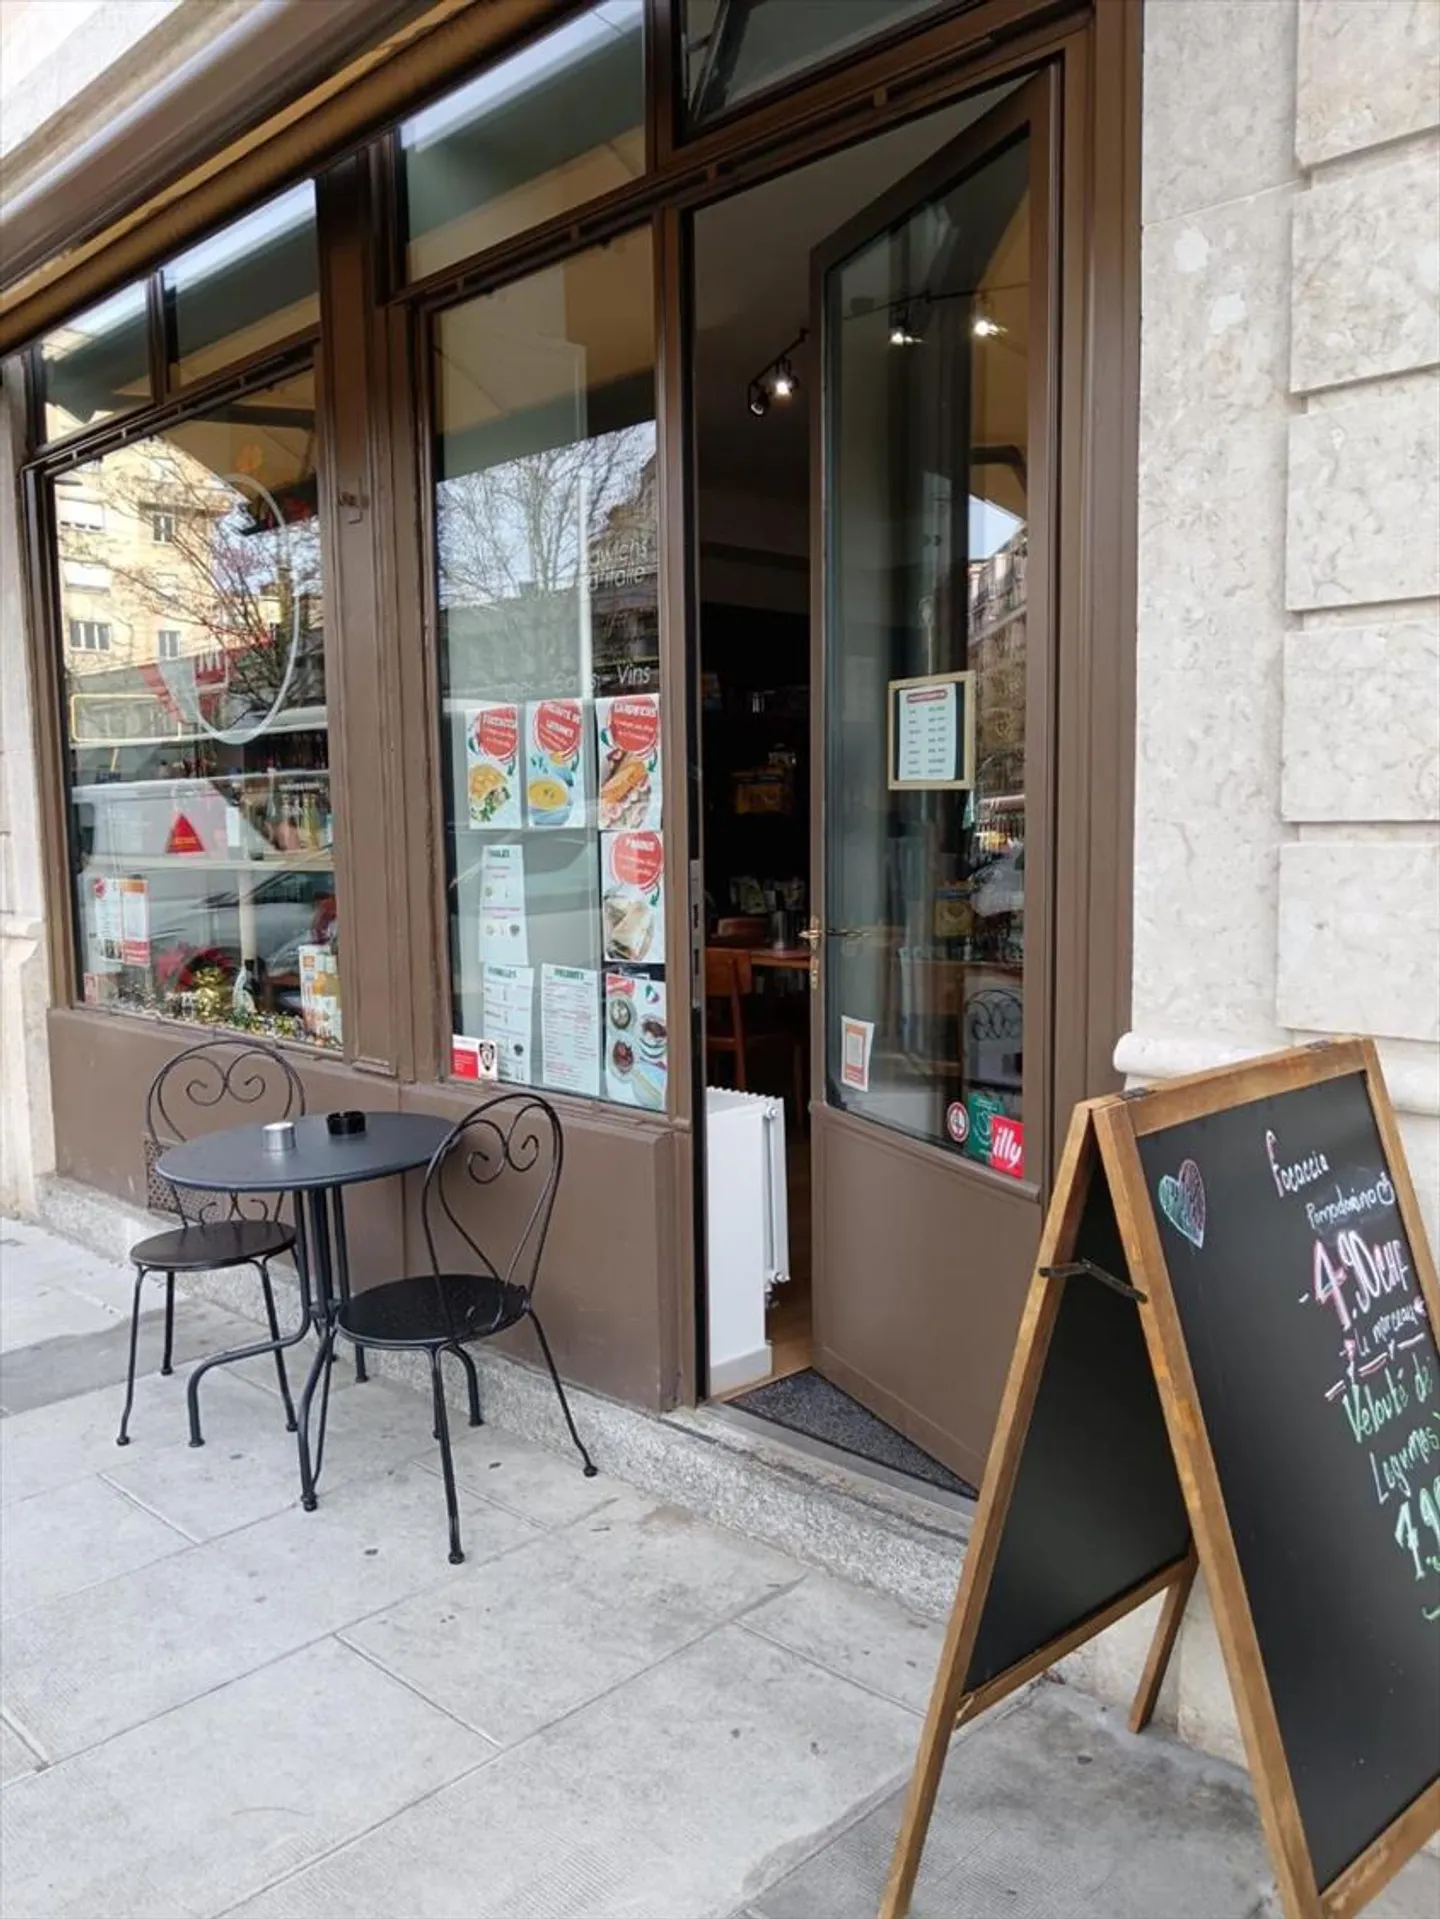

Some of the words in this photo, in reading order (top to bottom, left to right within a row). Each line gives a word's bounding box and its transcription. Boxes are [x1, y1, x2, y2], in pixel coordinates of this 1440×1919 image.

[616, 663, 651, 686] Vins
[992, 1127, 1022, 1169] illy
[1265, 1129, 1329, 1198] Focaccia
